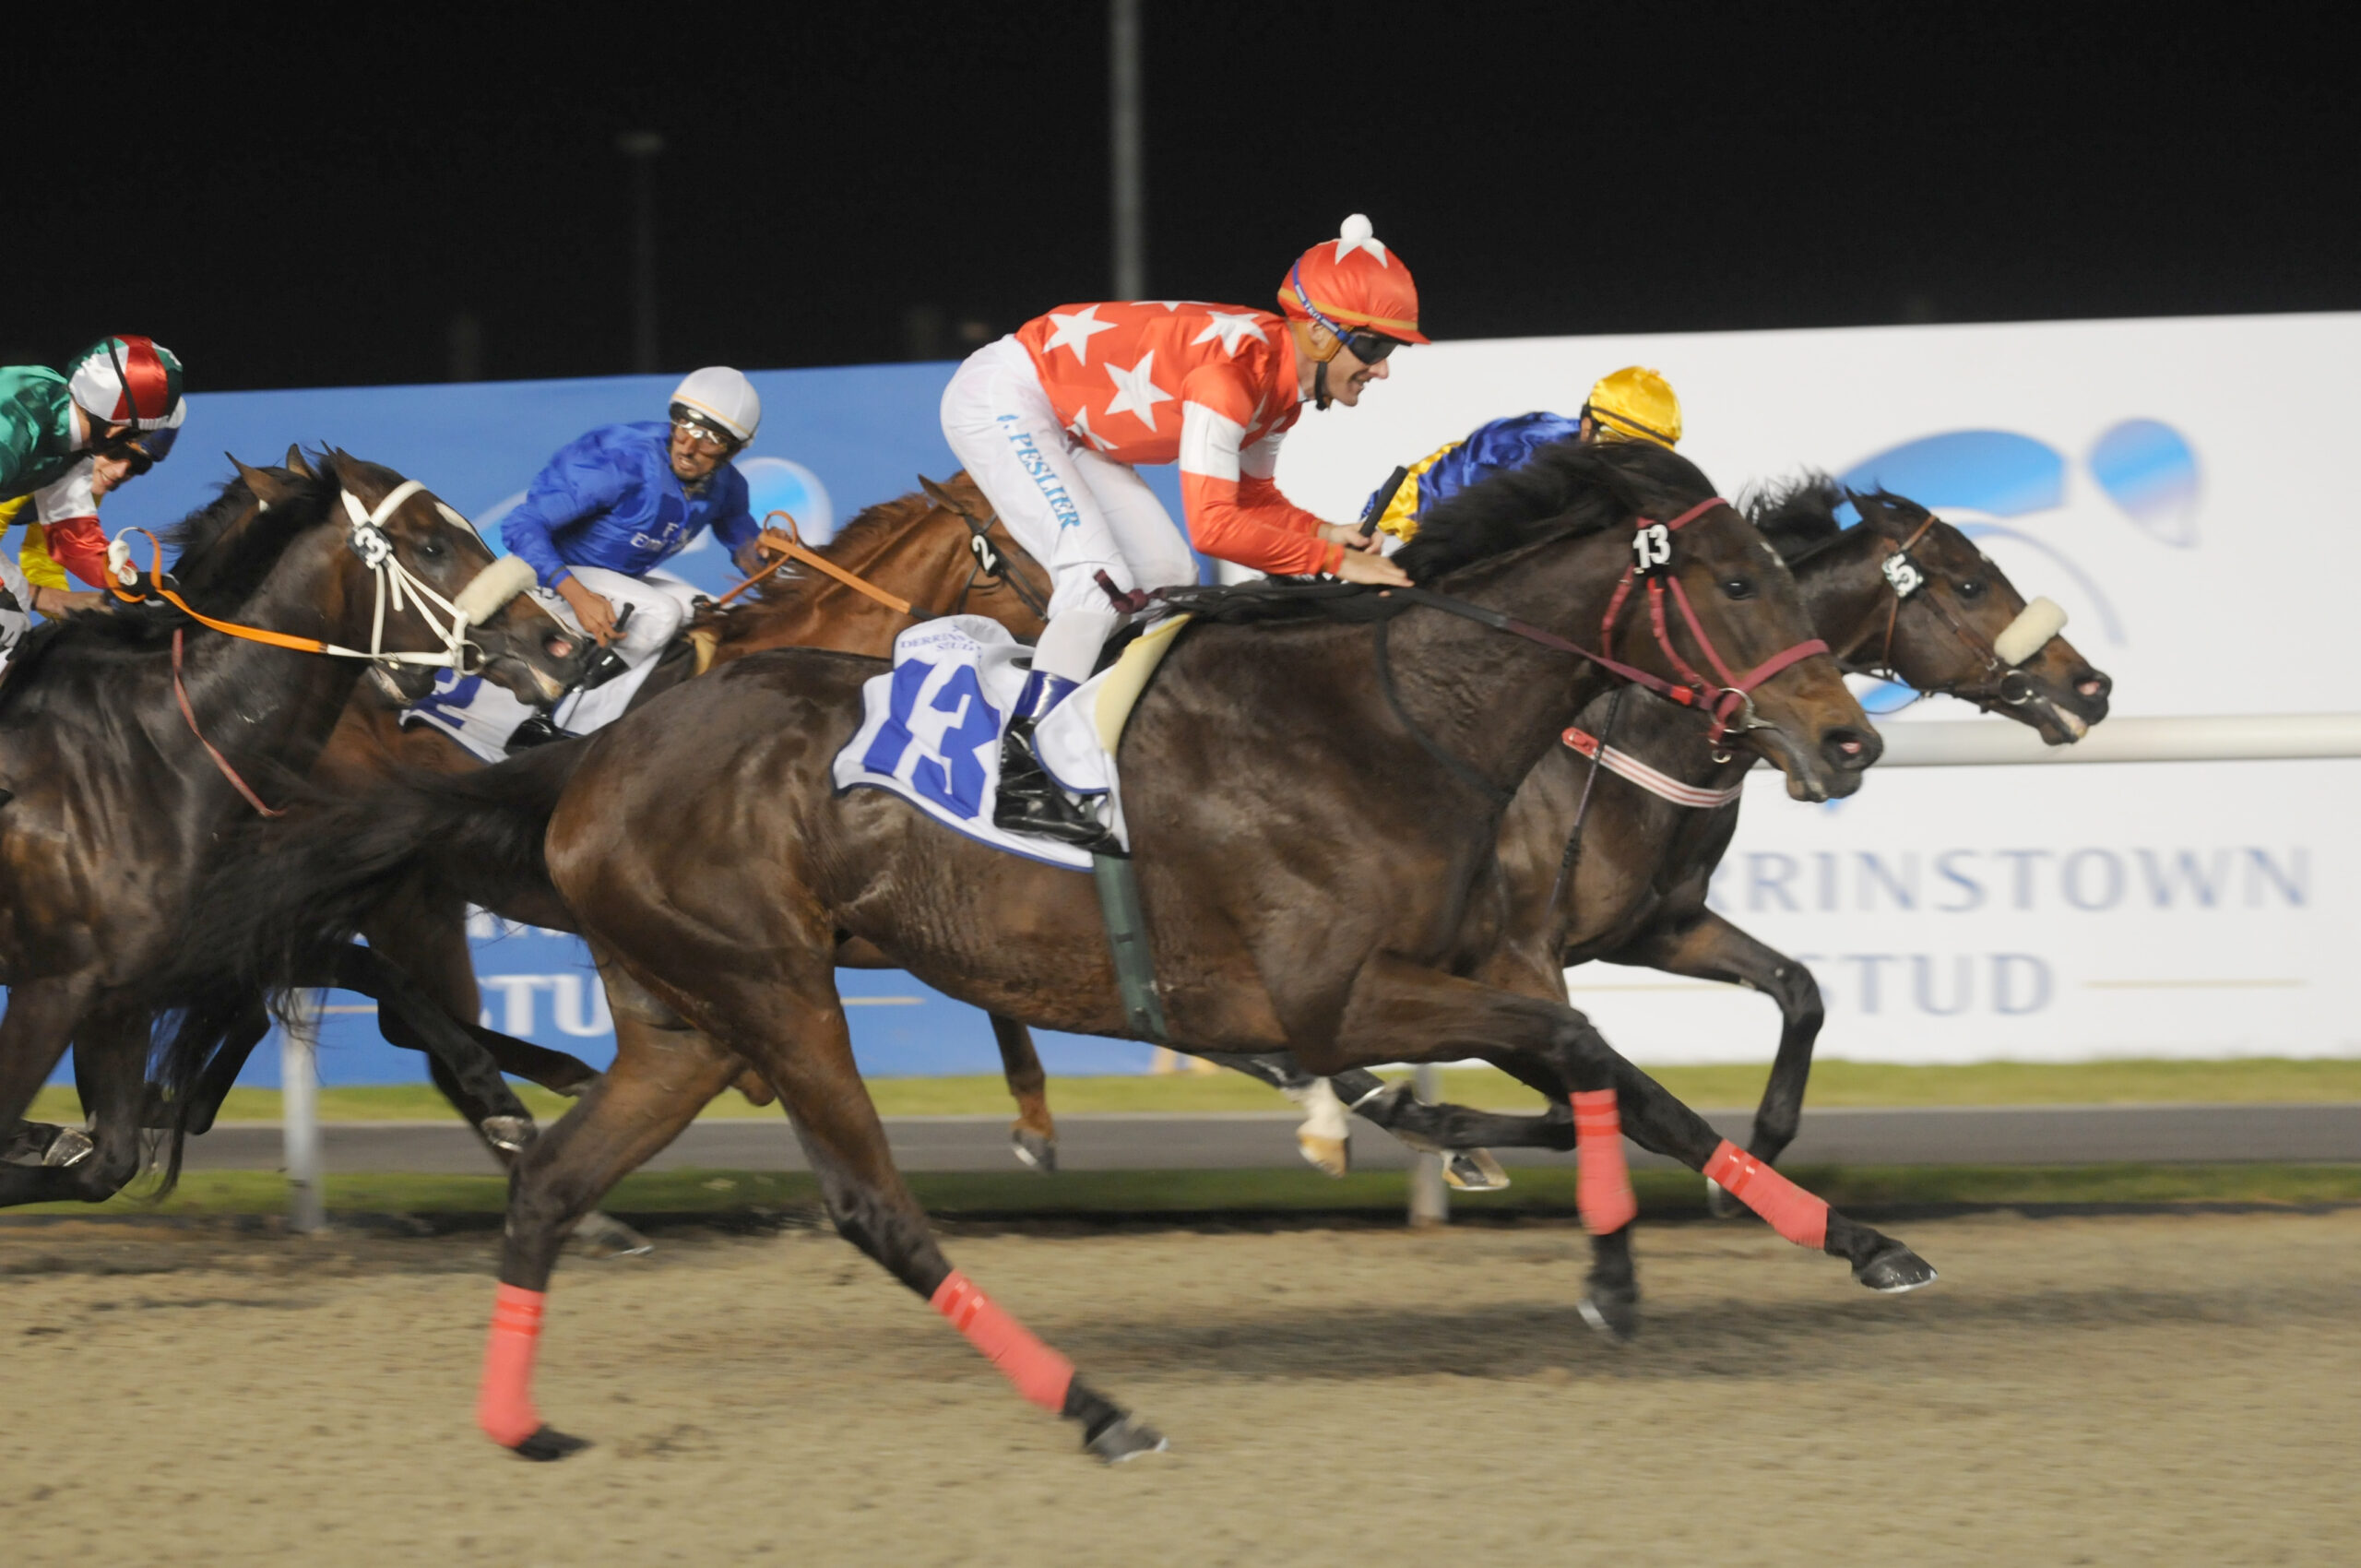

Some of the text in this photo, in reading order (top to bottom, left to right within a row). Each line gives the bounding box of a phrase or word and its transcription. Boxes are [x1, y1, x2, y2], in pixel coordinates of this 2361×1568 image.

[1008, 432, 1081, 530] PESLIER
[354, 527, 386, 564] 3
[972, 535, 996, 570] 2
[1632, 524, 1670, 568] 13
[1888, 553, 1916, 592] 5
[862, 658, 1001, 821] 13
[478, 974, 612, 1037] TU
